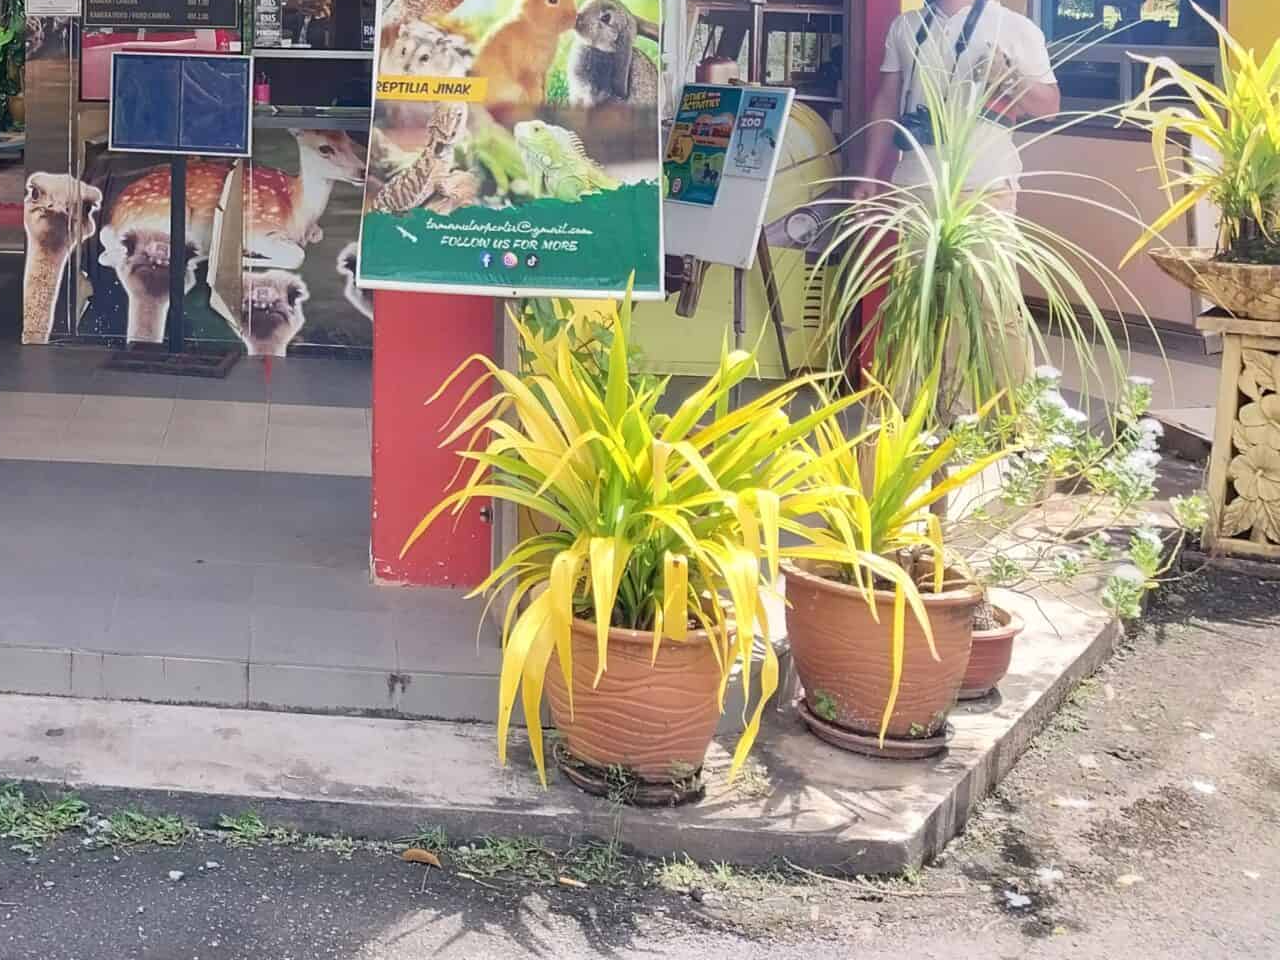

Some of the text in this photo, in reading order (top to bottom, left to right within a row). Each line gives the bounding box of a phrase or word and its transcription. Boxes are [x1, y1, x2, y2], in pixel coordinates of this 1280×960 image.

[433, 83, 472, 95] JINAK
[740, 118, 761, 128] ZOO
[440, 235, 579, 252] FOLLOW US FOR MORE
